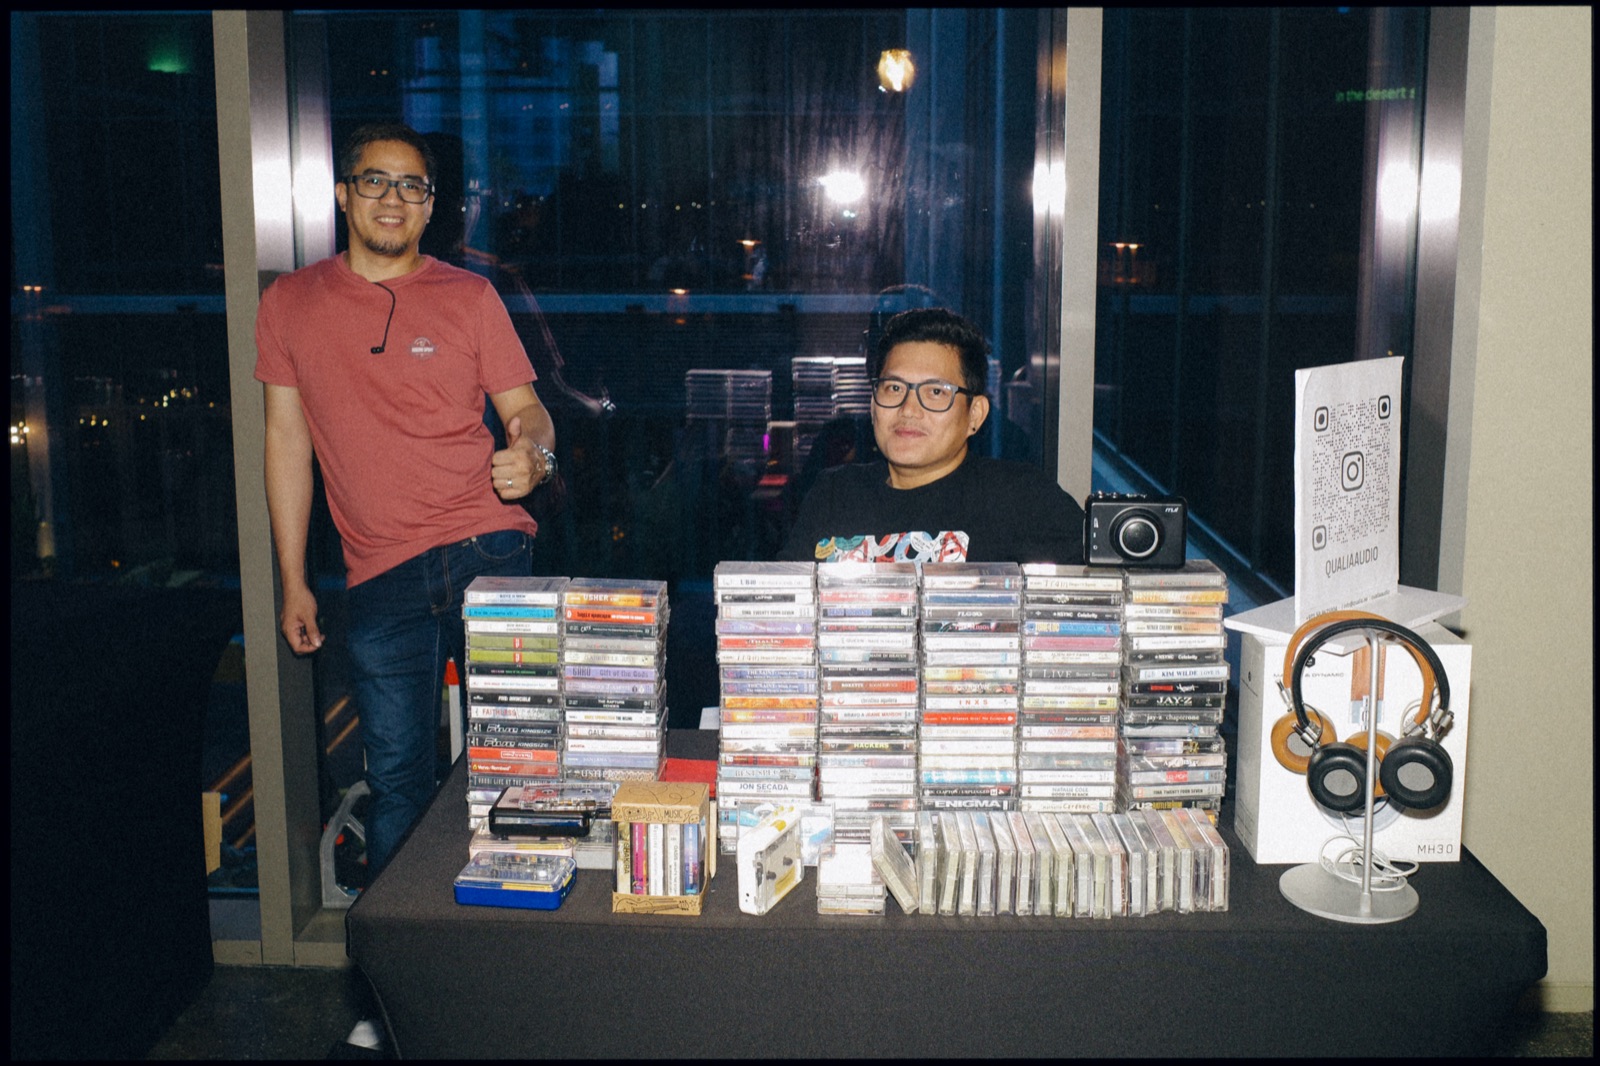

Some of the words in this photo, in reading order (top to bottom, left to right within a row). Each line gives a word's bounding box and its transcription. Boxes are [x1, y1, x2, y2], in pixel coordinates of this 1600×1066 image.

[1366, 87, 1406, 101] desert
[1325, 546, 1379, 578] QUALIAAUDIO
[583, 594, 609, 602] USHER
[612, 669, 620, 677] of
[621, 670, 631, 678] the
[633, 670, 648, 679] Gods
[1043, 669, 1072, 678] LIVE
[1157, 696, 1193, 704] JAY-Z
[588, 729, 606, 737] GALA
[740, 783, 754, 791] JON
[757, 783, 789, 791] SECADA
[935, 800, 1001, 808] ENIGMA
[1062, 802, 1090, 810] Cardone
[664, 809, 683, 819] MUSIC
[1417, 843, 1453, 854] MH30
